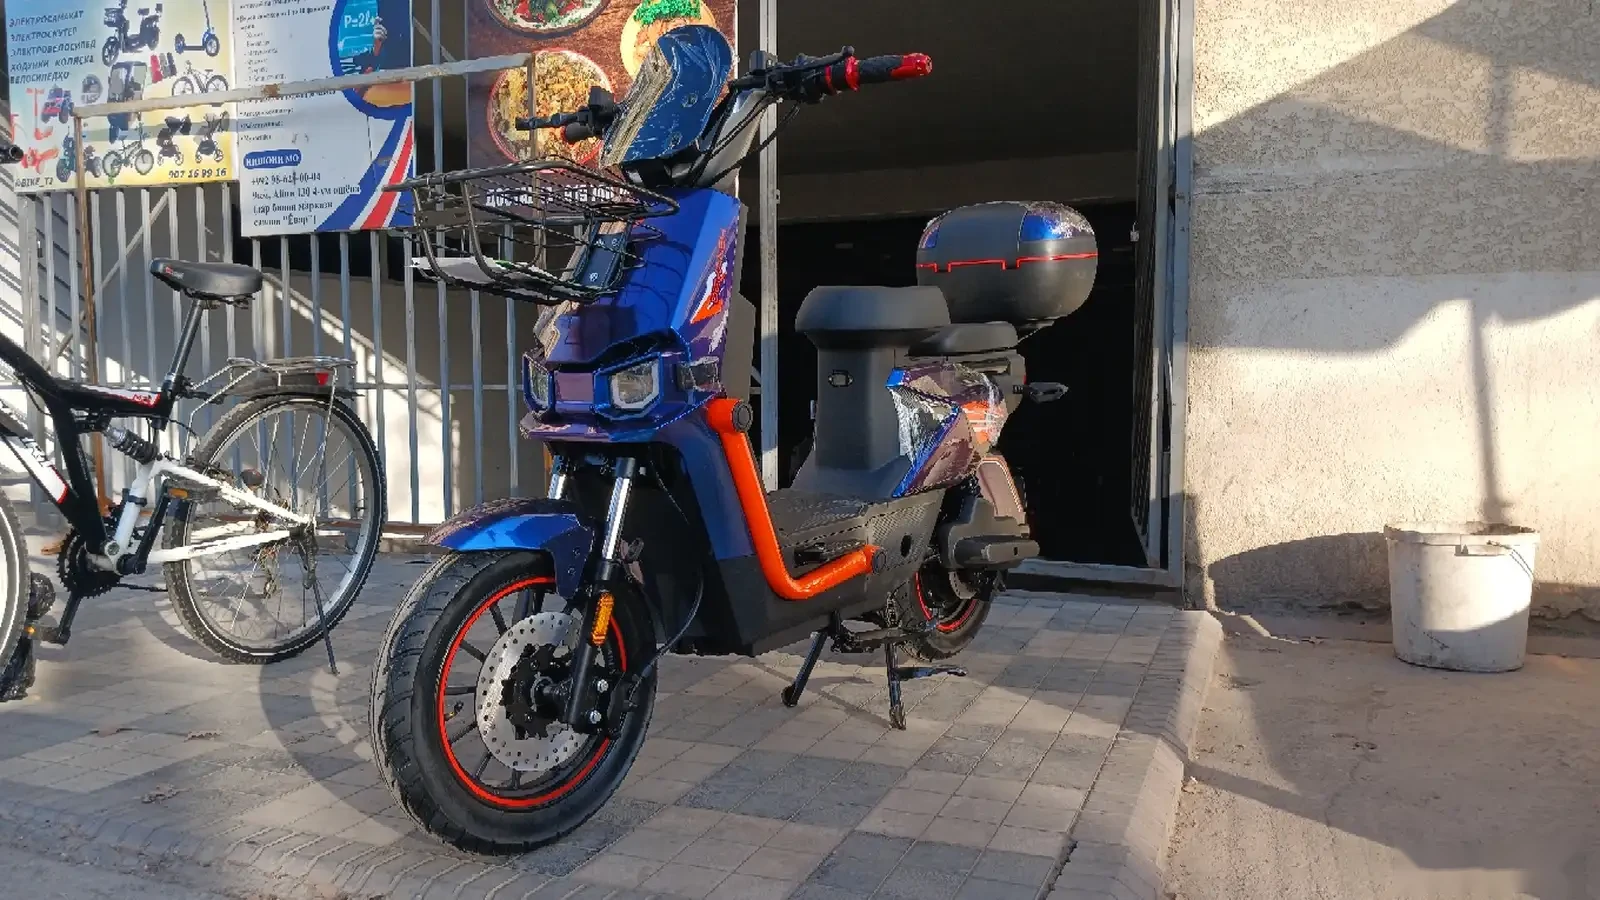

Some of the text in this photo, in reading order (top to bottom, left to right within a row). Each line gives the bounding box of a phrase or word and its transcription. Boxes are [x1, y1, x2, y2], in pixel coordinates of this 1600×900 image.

[285, 153, 300, 164] МО
[188, 168, 199, 178] 16
[216, 167, 227, 177] 16
